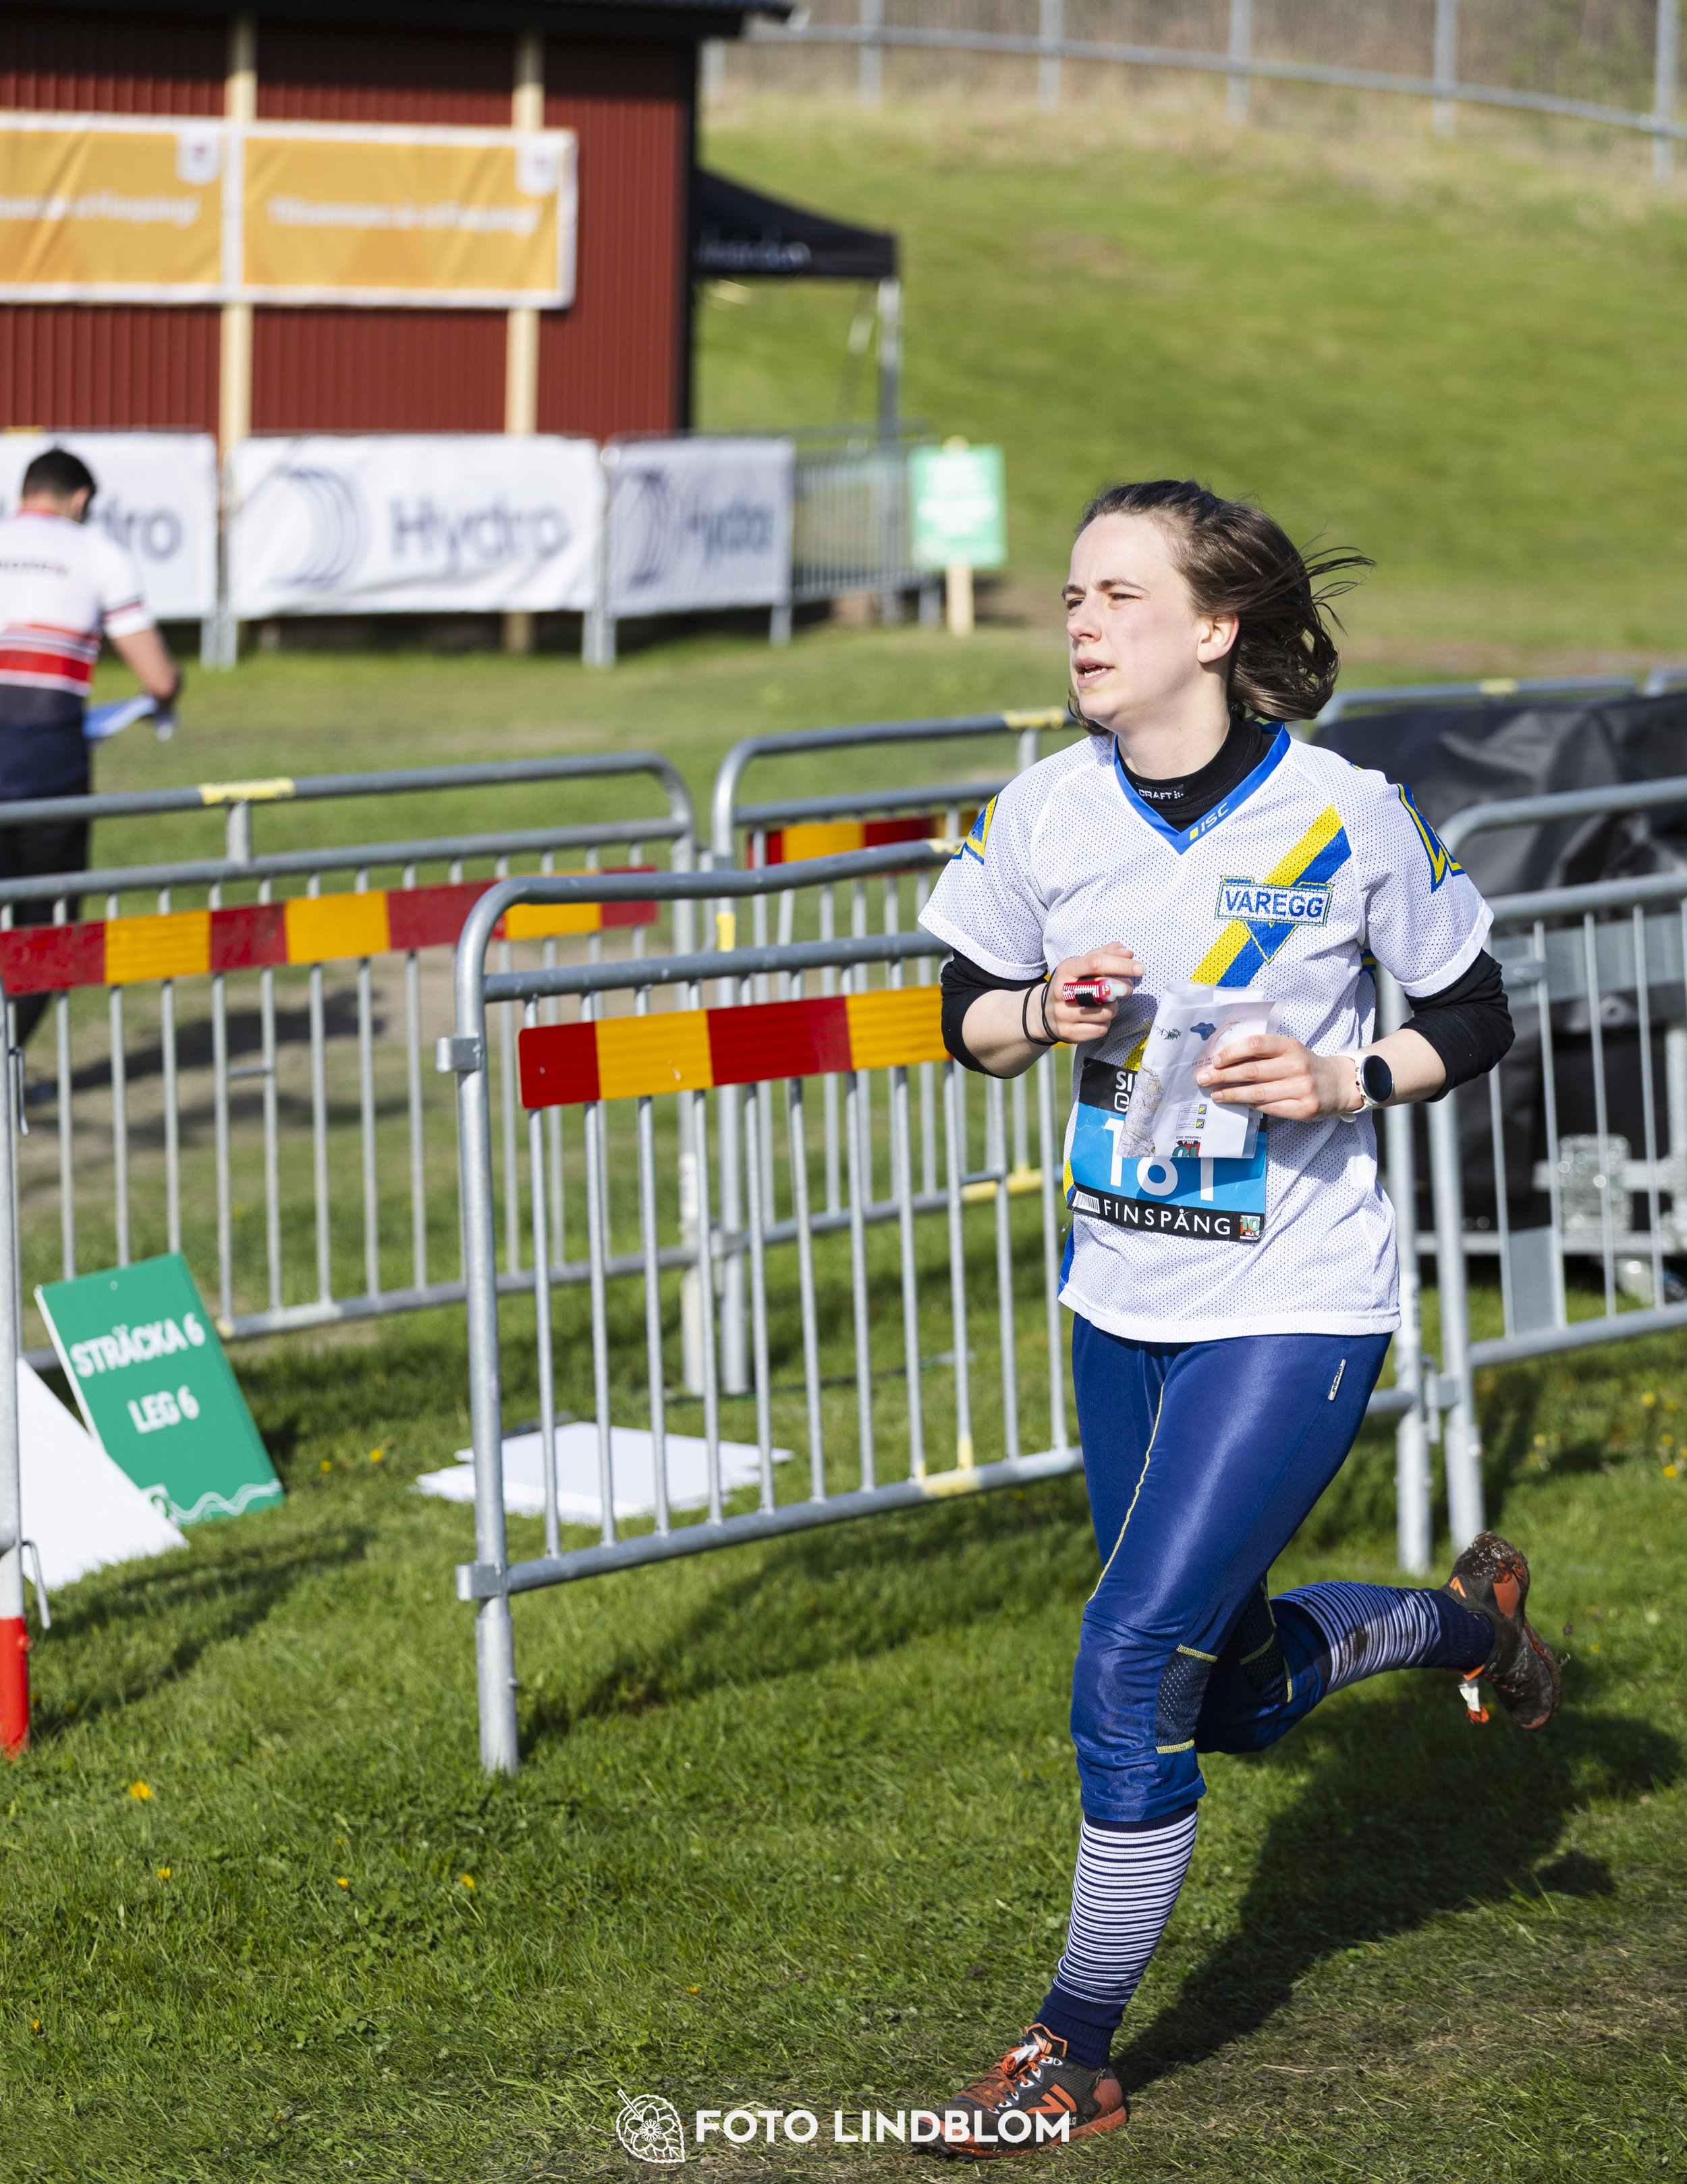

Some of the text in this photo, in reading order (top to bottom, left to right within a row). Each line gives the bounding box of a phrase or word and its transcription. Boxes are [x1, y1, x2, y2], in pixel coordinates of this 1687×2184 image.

[387, 496, 572, 574] Hydro
[1138, 789, 1171, 800] CRAFT
[1201, 802, 1229, 832] ISC
[1225, 890, 1323, 918] VAREGG
[1101, 1118, 1214, 1202] 161
[1103, 1199, 1230, 1235] FINSPÅNG
[1240, 1217, 1260, 1232] 10
[70, 1312, 205, 1377] STRÄCKA 6
[127, 1384, 200, 1434] LEG 6
